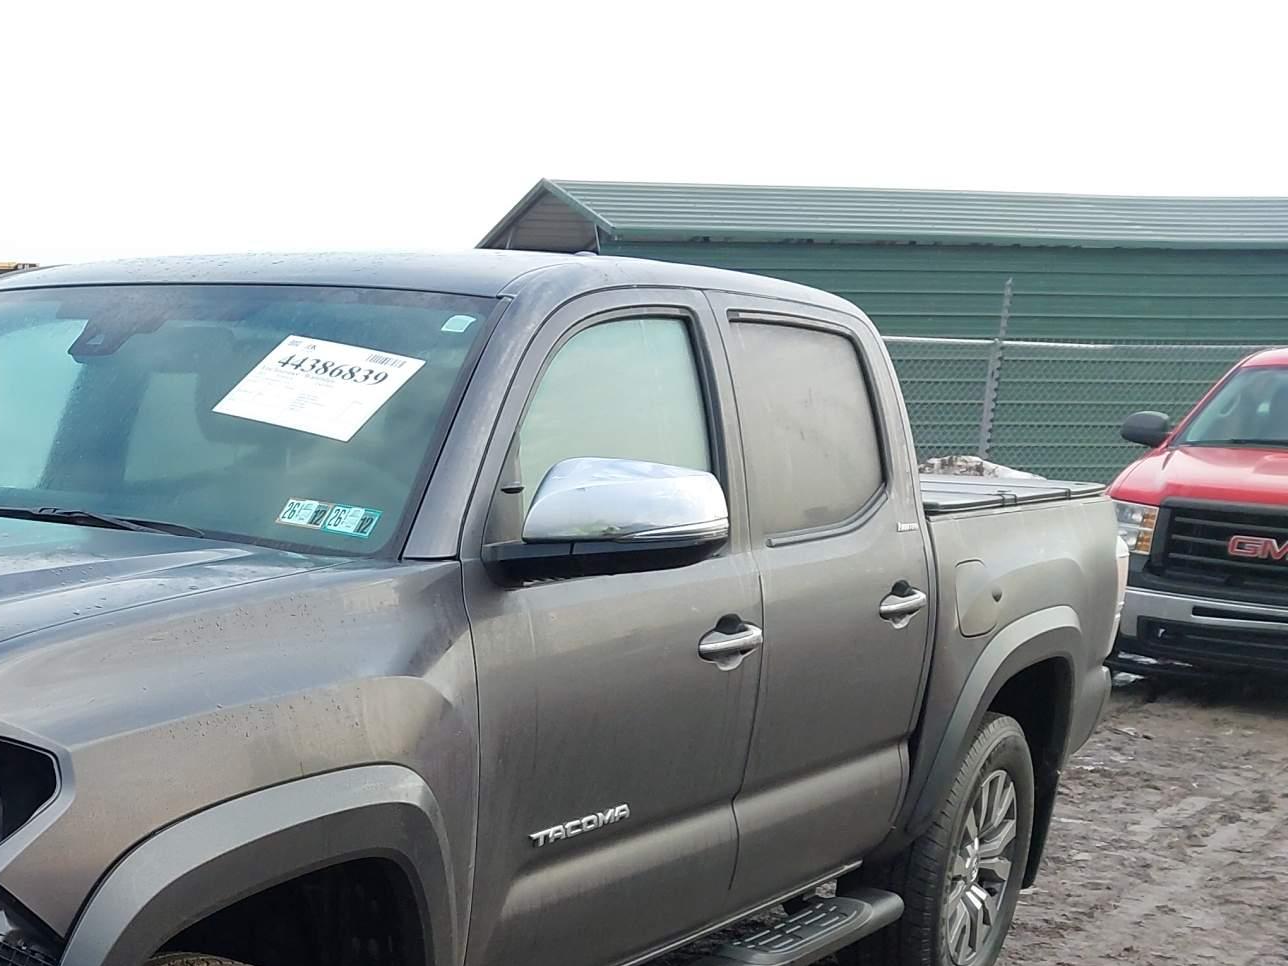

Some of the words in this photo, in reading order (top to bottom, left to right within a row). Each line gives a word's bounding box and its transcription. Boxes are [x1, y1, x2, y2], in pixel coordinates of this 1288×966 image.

[278, 353, 389, 386] 44386839
[281, 501, 301, 520] 26
[309, 509, 328, 526] 12
[327, 508, 347, 527] 26
[355, 516, 374, 534] 12
[529, 803, 630, 847] TACOMA
